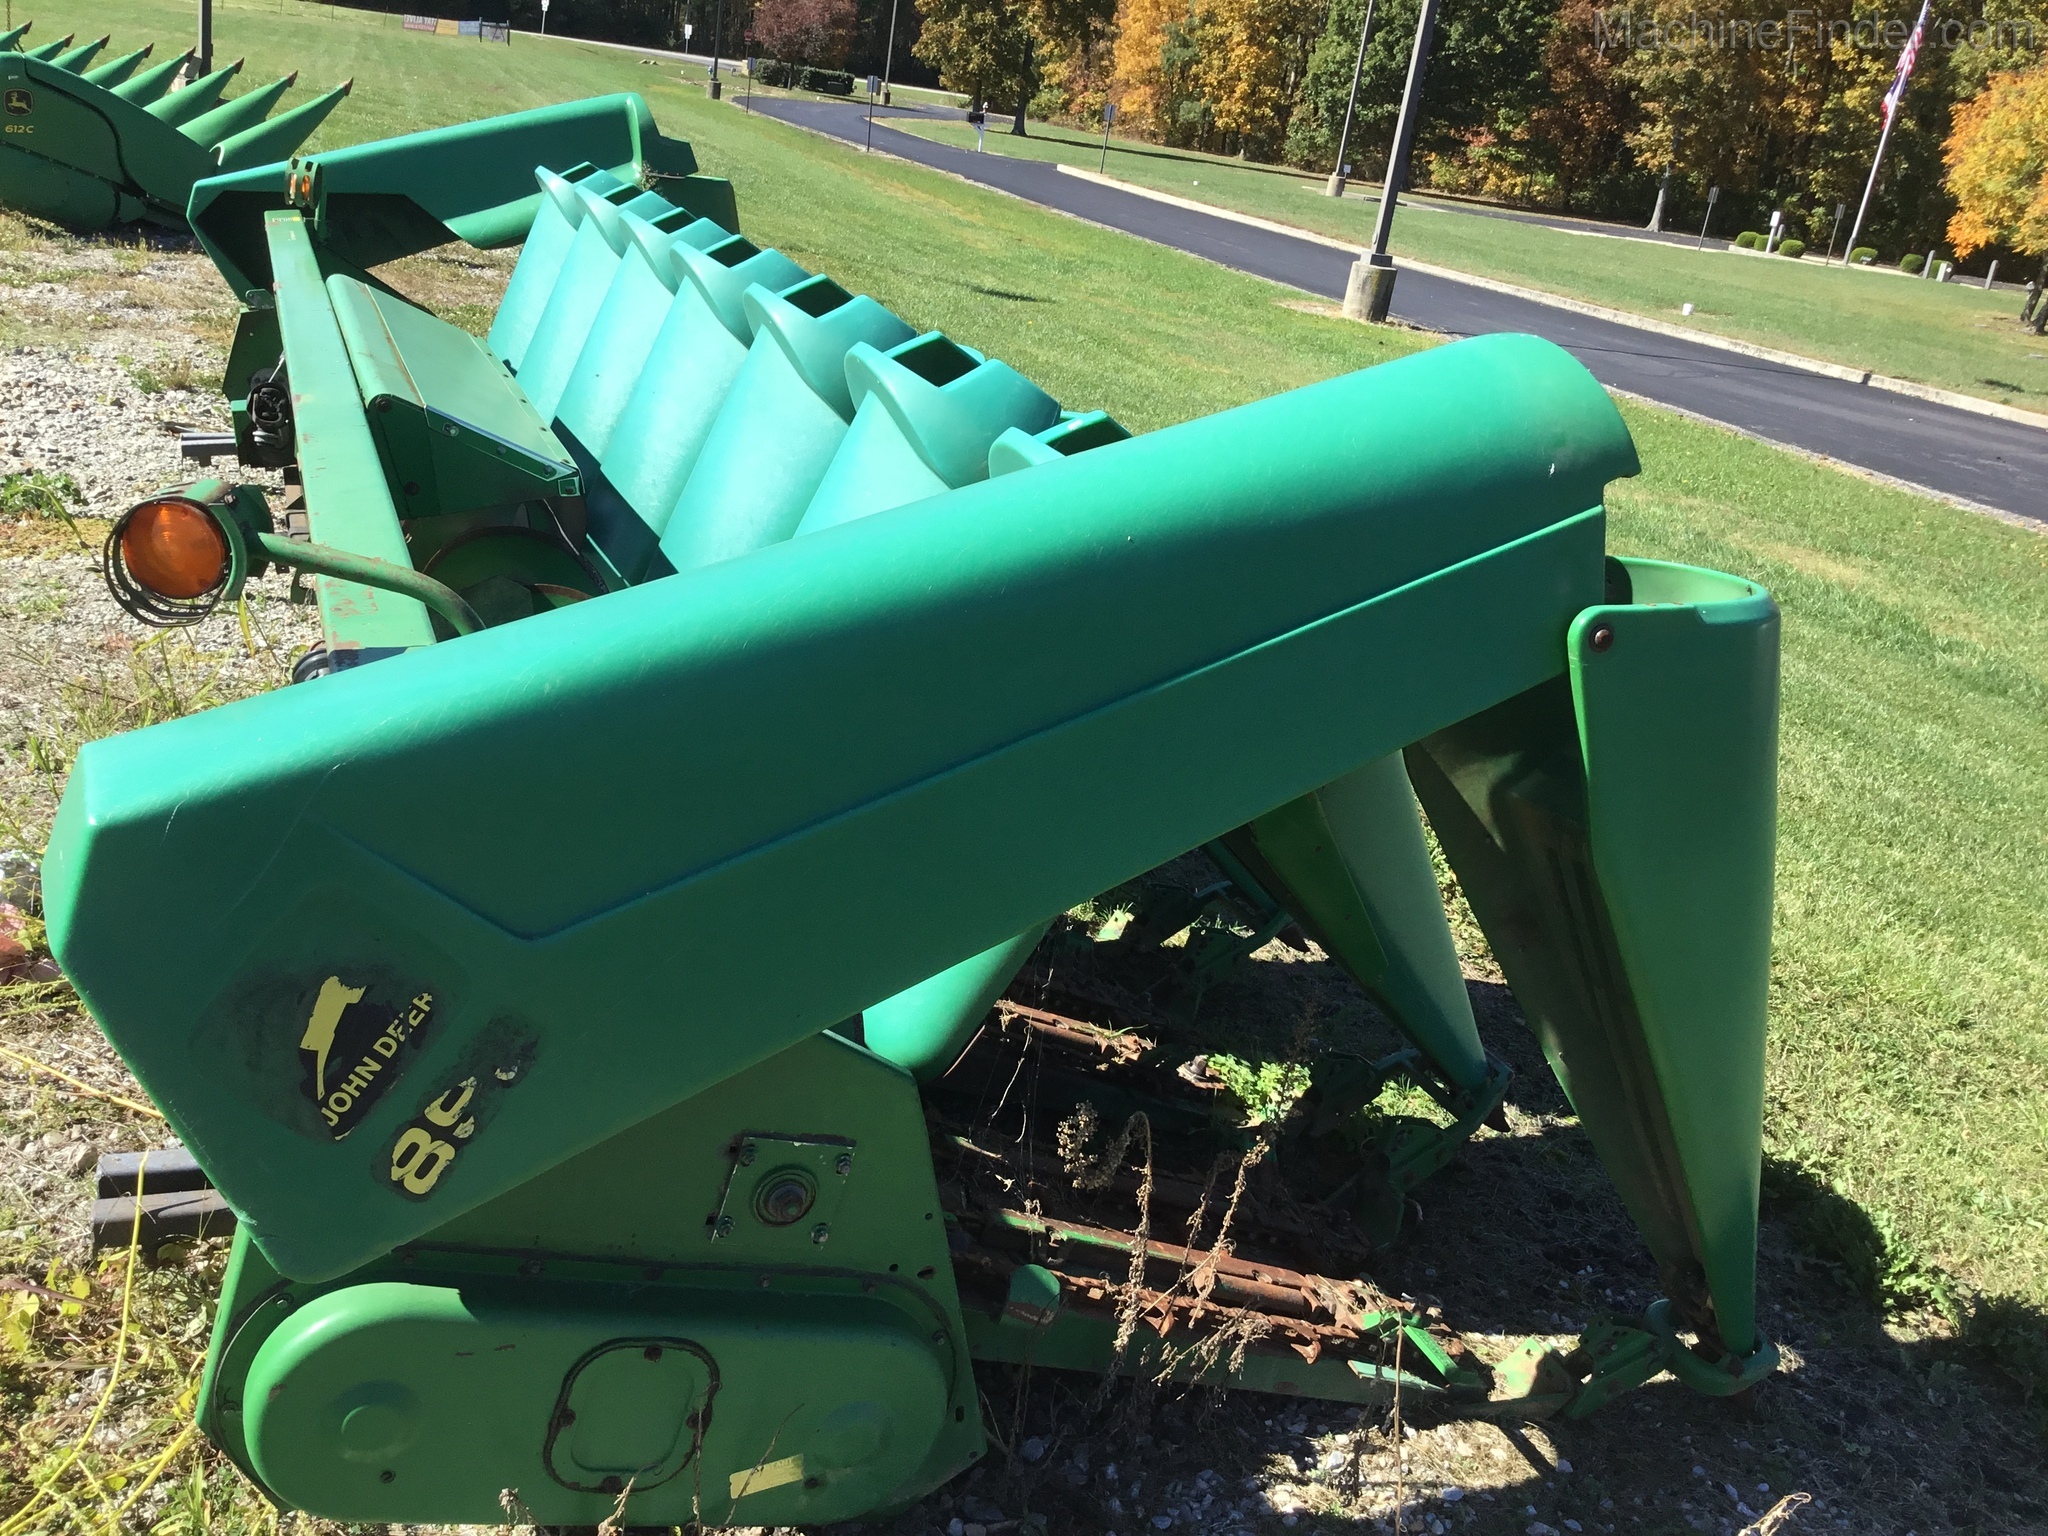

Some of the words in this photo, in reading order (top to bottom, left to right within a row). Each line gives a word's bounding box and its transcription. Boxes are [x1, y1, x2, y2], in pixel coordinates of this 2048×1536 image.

[5, 124, 35, 134] 612C
[321, 1056, 383, 1127] JOHN
[391, 1060, 520, 1195] 89
